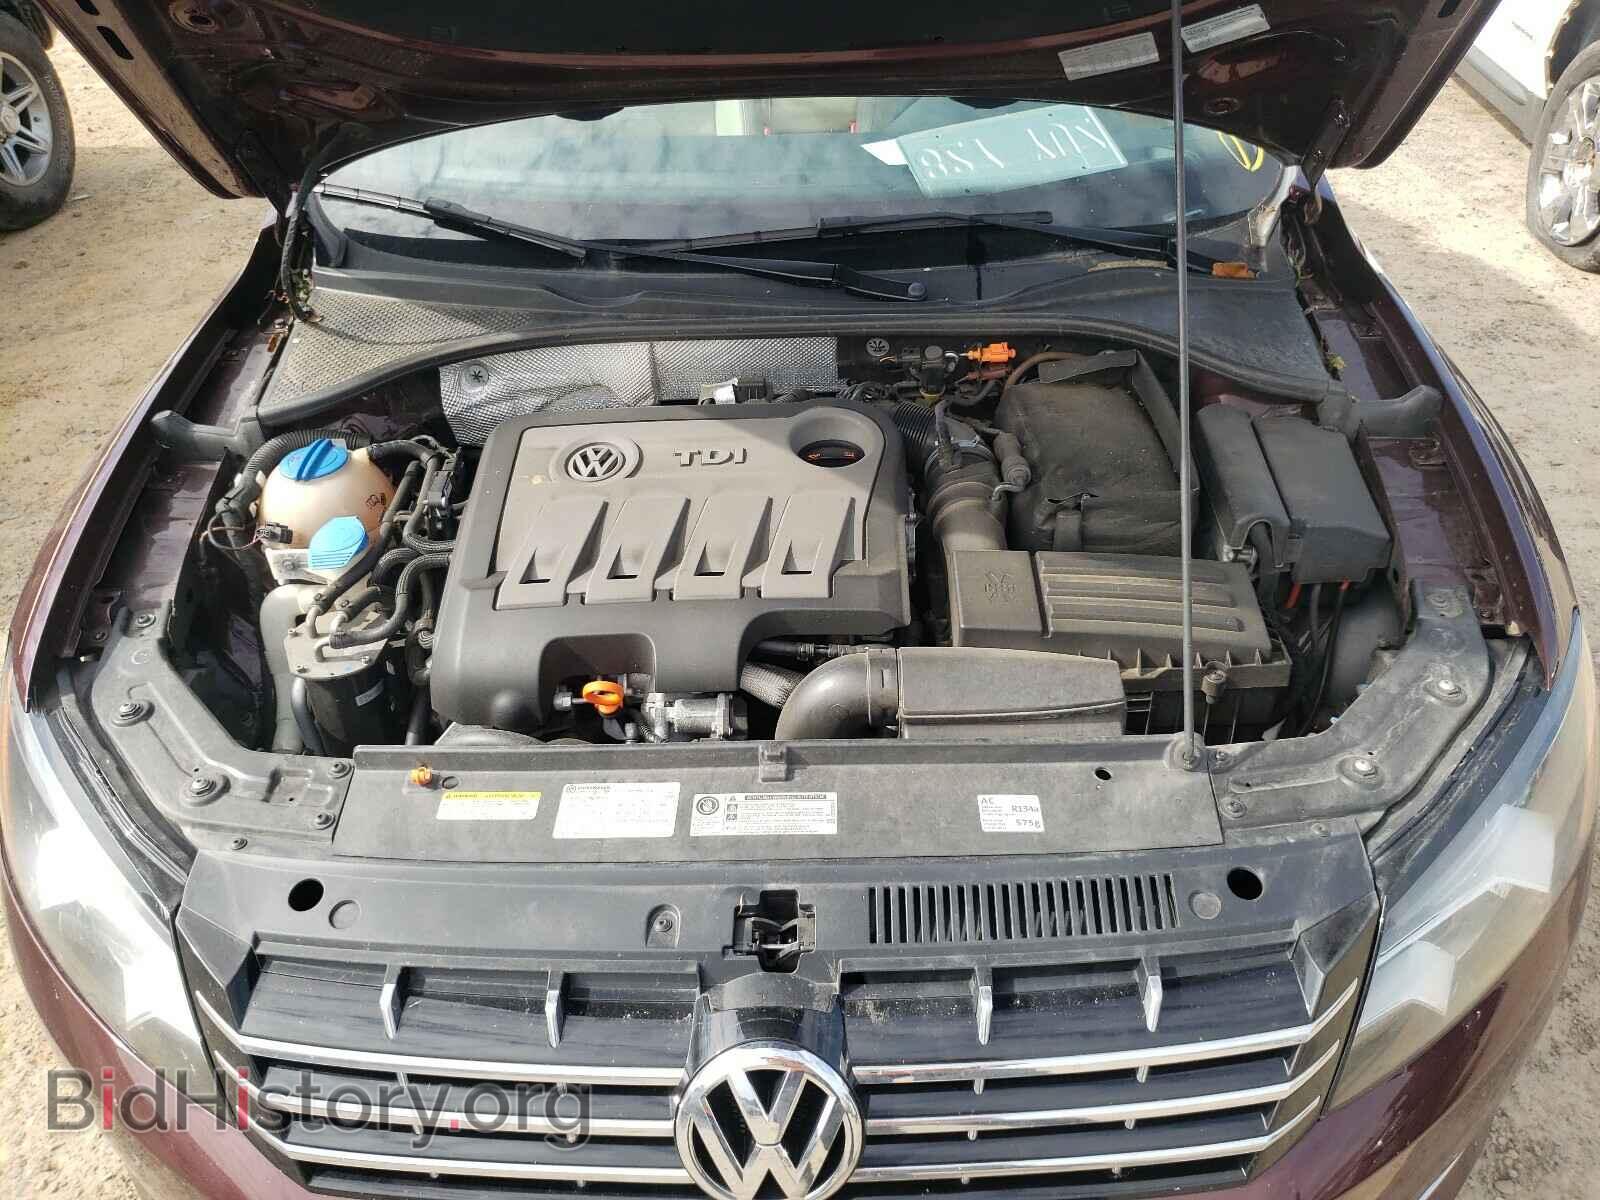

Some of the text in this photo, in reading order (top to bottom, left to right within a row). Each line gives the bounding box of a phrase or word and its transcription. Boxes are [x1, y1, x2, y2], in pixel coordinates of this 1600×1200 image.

[565, 442, 626, 482] VW
[672, 447, 748, 468] TDI
[1011, 805, 1040, 813] R134a
[675, 1039, 864, 1200] VW
